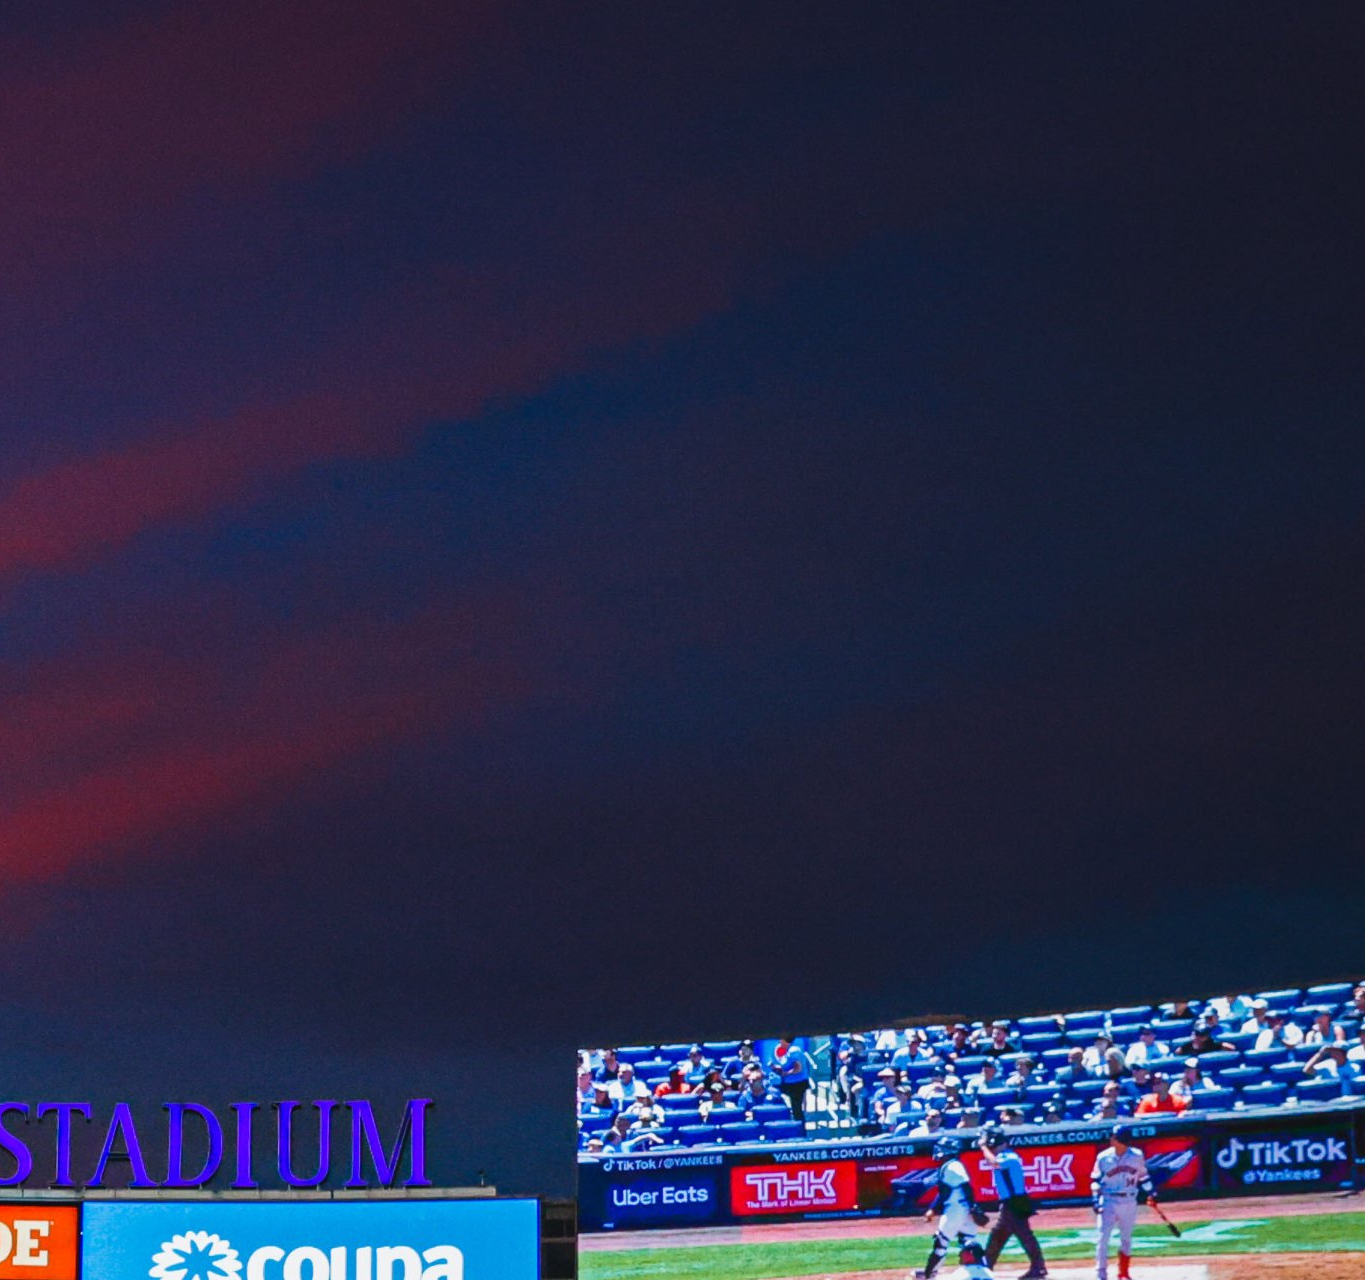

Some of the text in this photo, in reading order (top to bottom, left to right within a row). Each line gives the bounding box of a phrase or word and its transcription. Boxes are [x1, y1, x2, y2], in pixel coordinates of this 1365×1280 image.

[773, 1145, 914, 1162] YANKEES.COM/TICKETS
[1248, 1138, 1346, 1166] TikTok
[616, 1159, 657, 1171] TikTok
[1243, 1167, 1320, 1183] @Yankees
[745, 1169, 836, 1200] THK
[613, 1186, 708, 1206] Uber Eats
